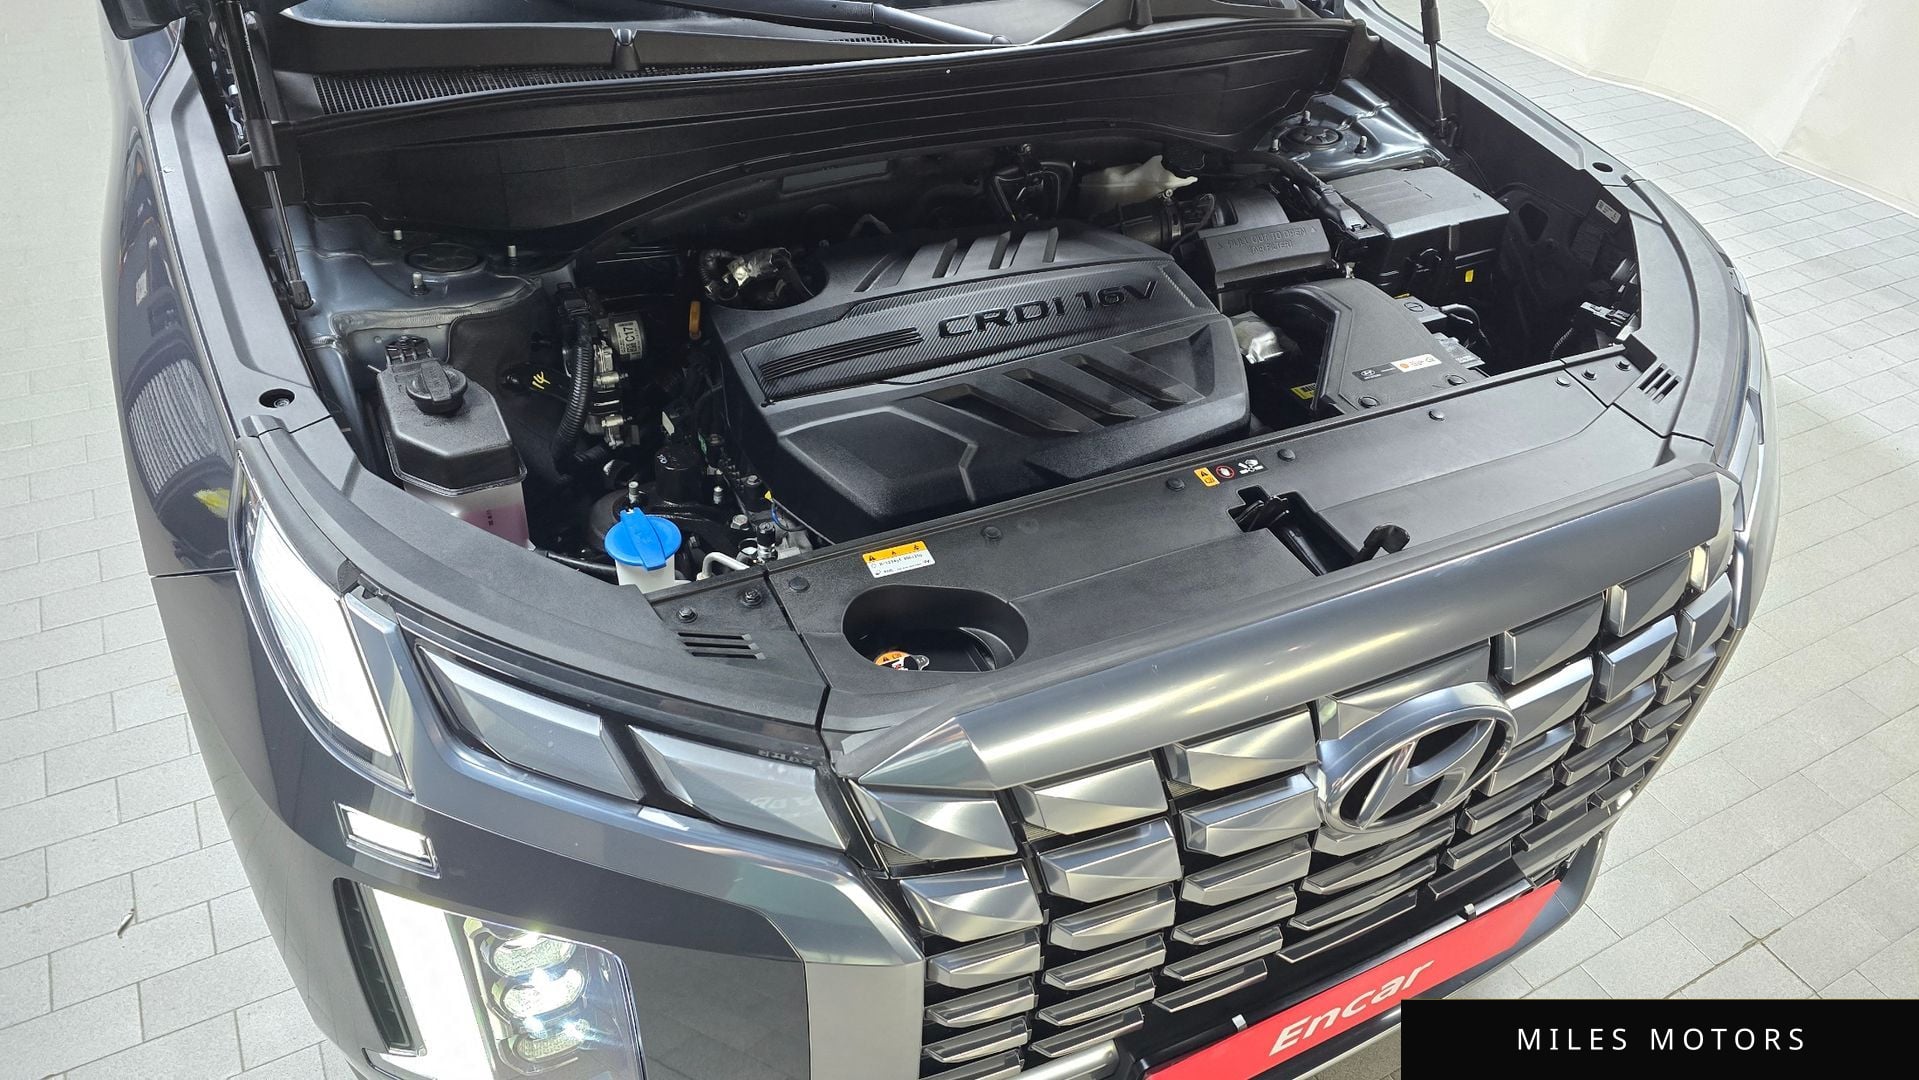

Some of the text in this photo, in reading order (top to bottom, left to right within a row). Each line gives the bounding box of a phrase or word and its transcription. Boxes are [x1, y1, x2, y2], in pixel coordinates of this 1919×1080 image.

[1271, 230, 1281, 240] TO
[938, 279, 1158, 339] CRDI 16V
[1268, 959, 1435, 1057] Encar
